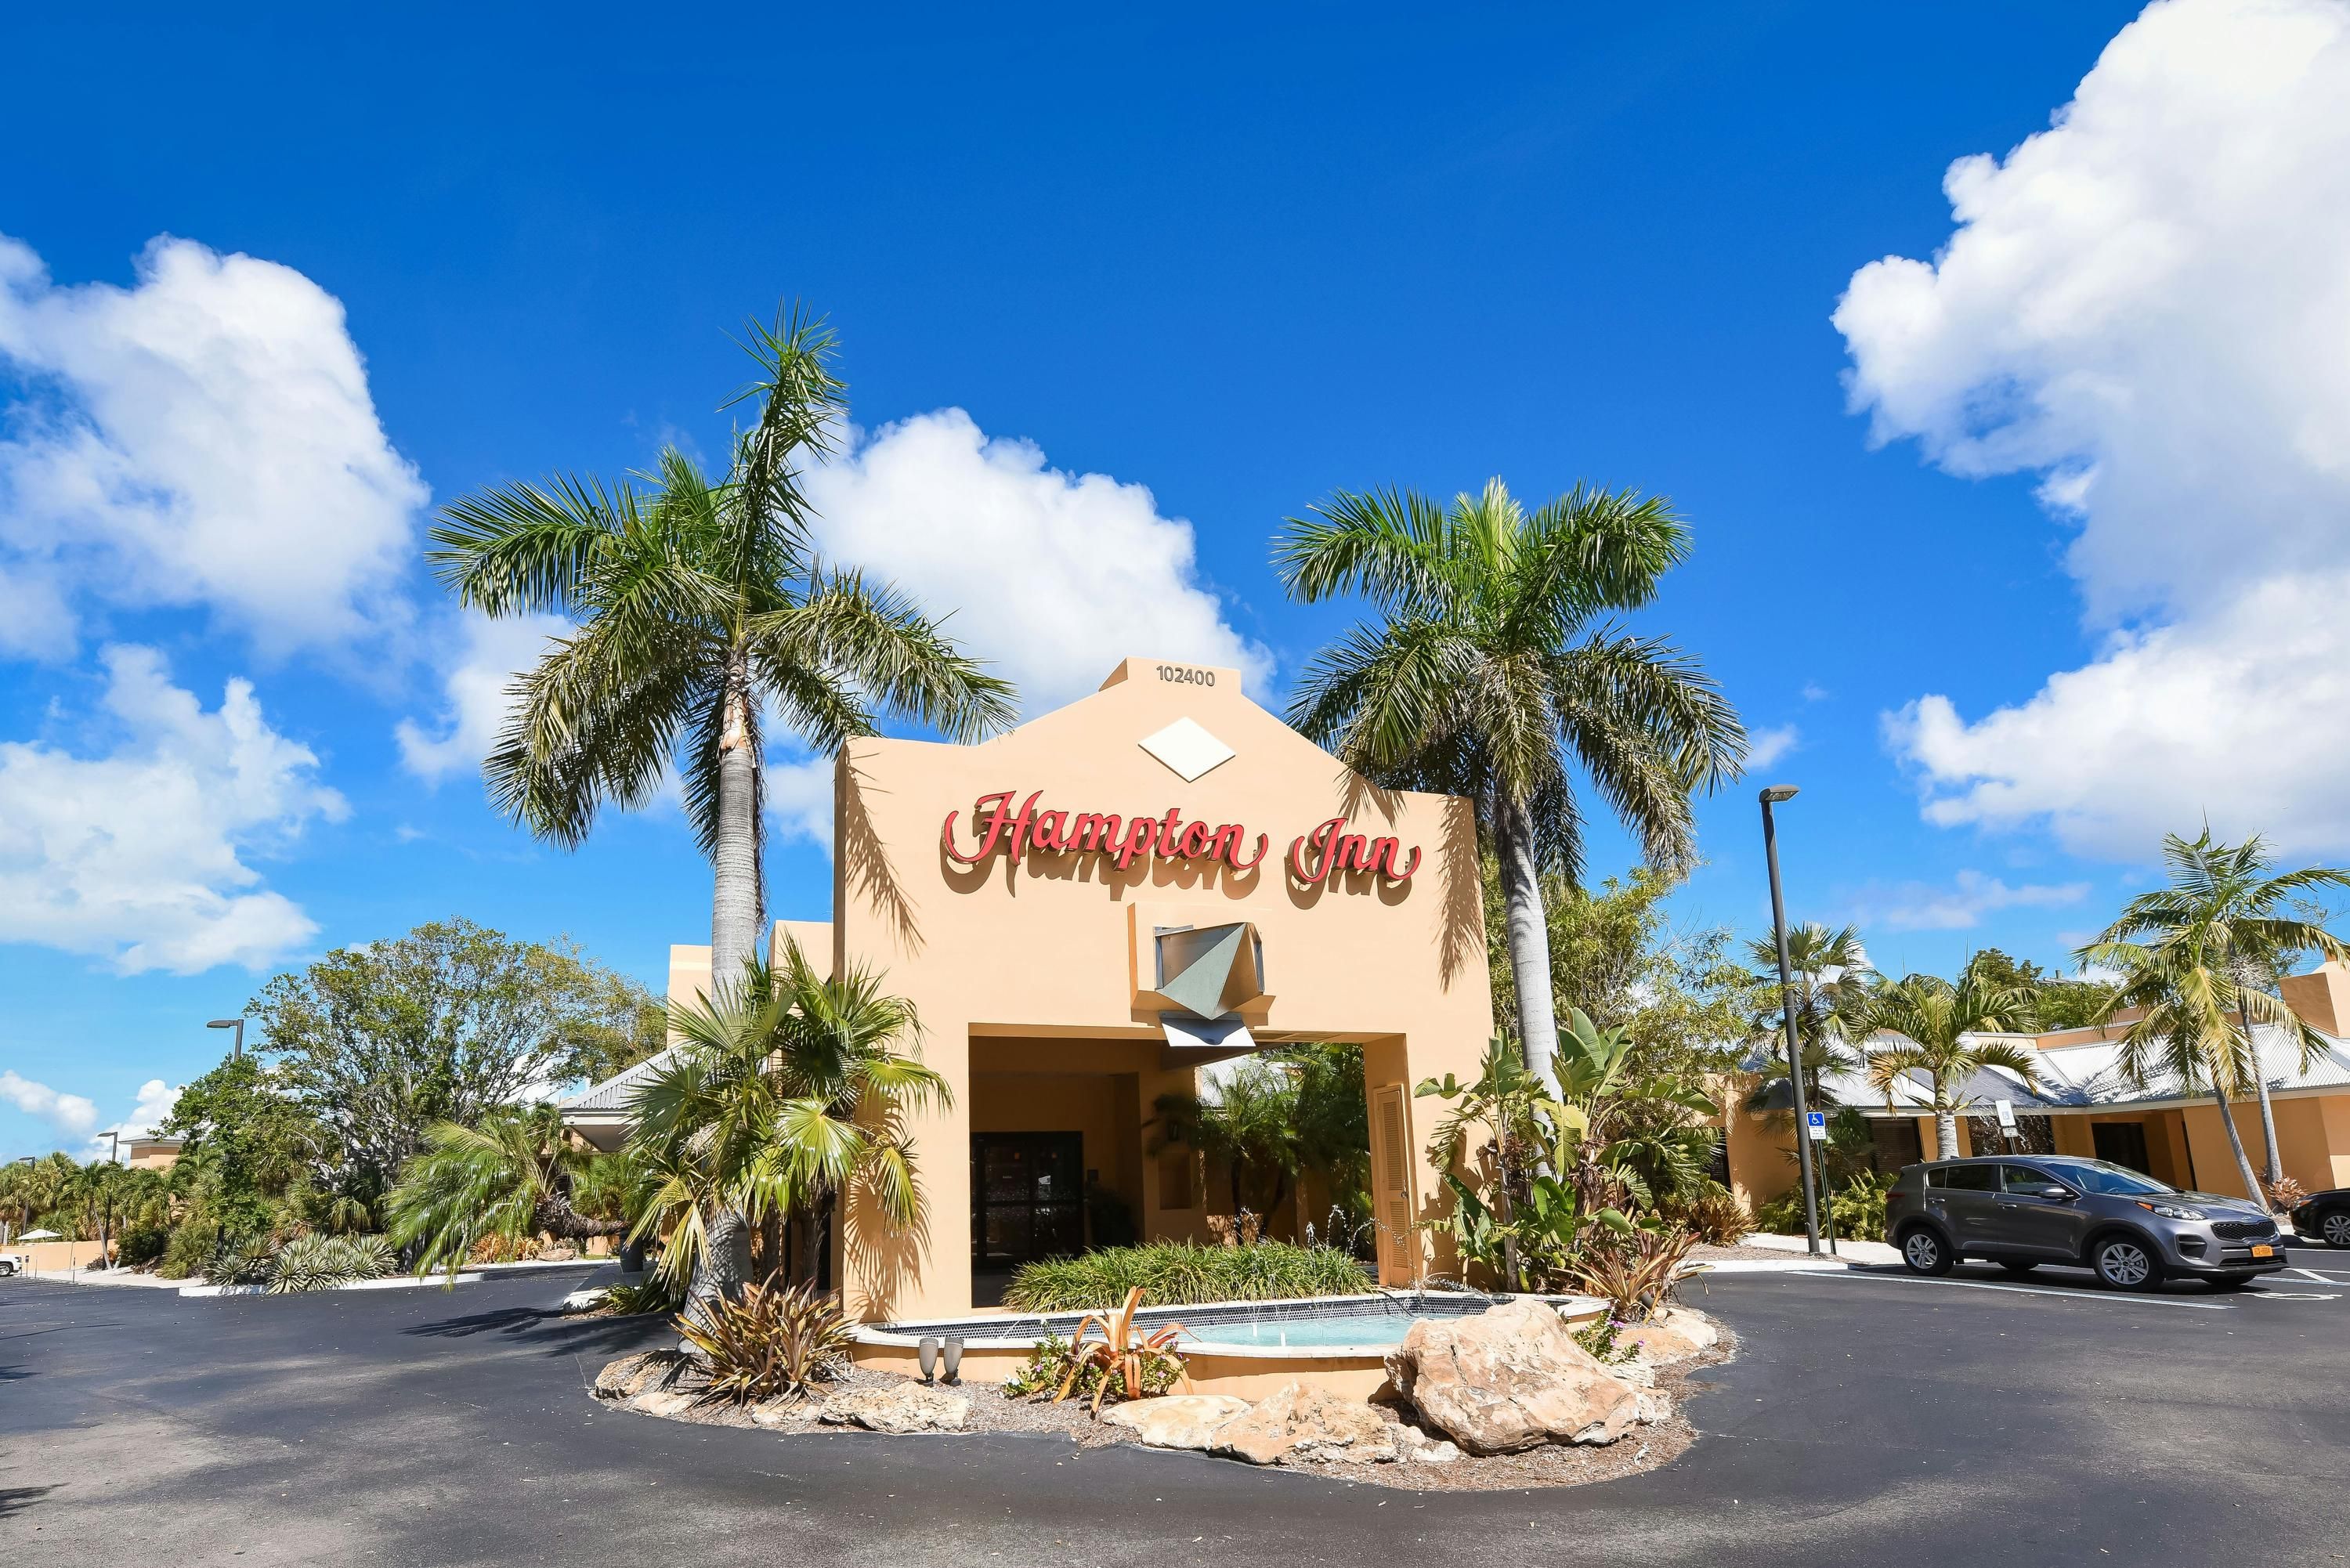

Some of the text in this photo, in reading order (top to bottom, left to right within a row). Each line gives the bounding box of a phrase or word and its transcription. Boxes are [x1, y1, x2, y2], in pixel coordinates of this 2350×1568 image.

[1156, 665, 1216, 687] 102400
[942, 789, 1422, 883] Hampton Inn
